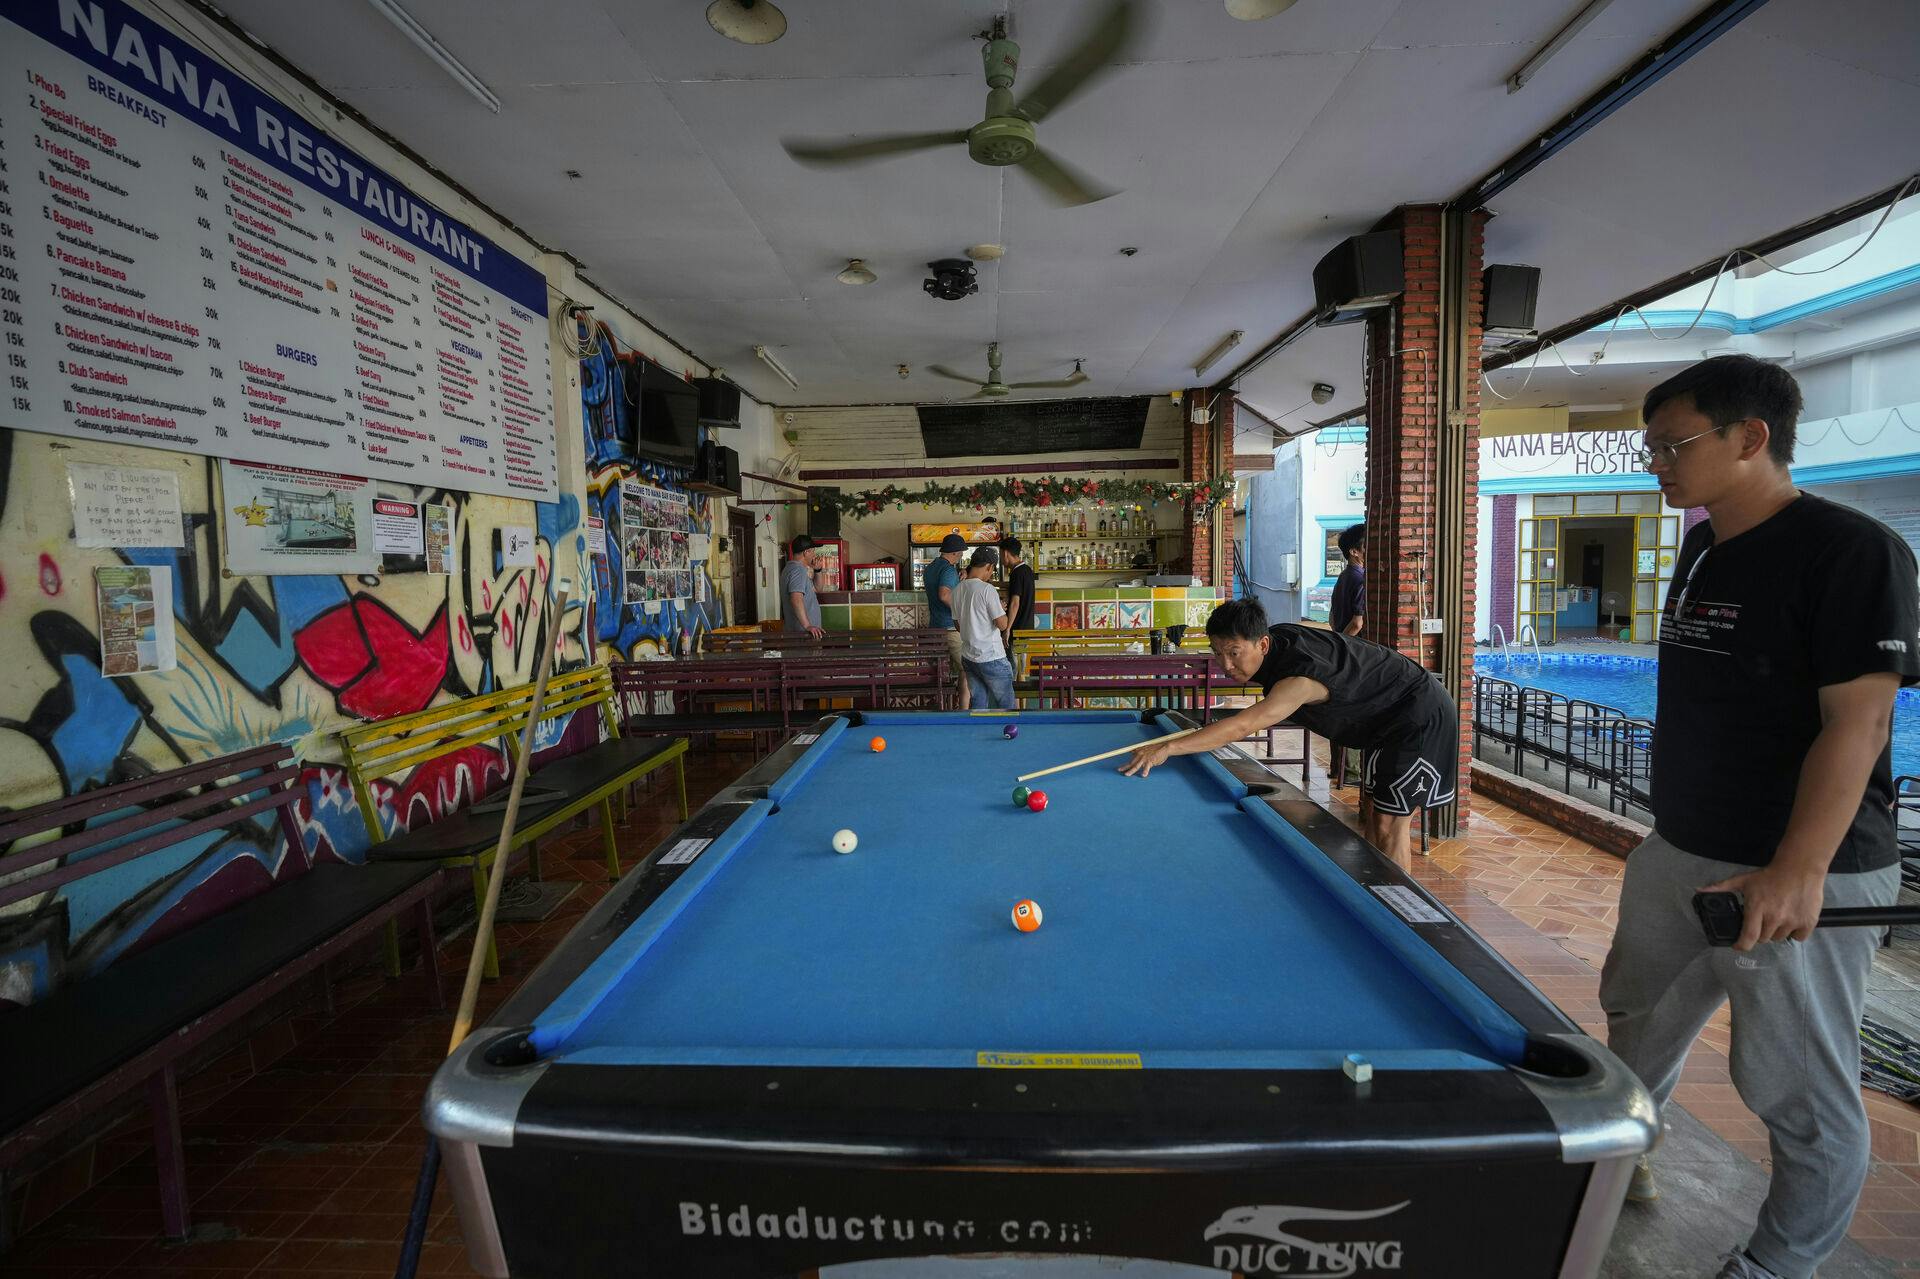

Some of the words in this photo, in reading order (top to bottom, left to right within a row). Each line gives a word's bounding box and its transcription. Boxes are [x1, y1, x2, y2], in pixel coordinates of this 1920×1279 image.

[34, 72, 53, 94] Pho
[54, 83, 66, 101] Bo
[87, 74, 167, 129] BREAKFAST
[28, 93, 39, 110] 2.
[40, 99, 74, 127] Special
[74, 116, 97, 138] Fried
[97, 127, 118, 148] Eggs
[57, 0, 241, 133] NANA
[256, 106, 484, 271] RESTAURANT
[34, 133, 44, 150] 3.
[44, 138, 69, 162] Fried
[69, 149, 91, 170] Eggs
[192, 155, 206, 171] 60k
[227, 153, 247, 172] Grilled
[247, 166, 267, 184] cheese
[268, 178, 294, 198] sandwich
[48, 174, 91, 202] Omelette
[195, 185, 208, 200] 50k
[231, 180, 245, 196] Ham
[245, 188, 267, 206] cheese
[267, 199, 293, 220] sandwich
[42, 205, 52, 221] 5.
[52, 209, 94, 235] Baguette
[233, 207, 249, 224] Tuna
[249, 215, 277, 237] Sandwich
[200, 245, 214, 261] 30k
[236, 237, 261, 256] Chicken
[261, 247, 288, 268] Sandwich
[361, 226, 384, 249] LUNCH
[392, 243, 416, 265] DINNER
[46, 243, 56, 259] 6.
[56, 247, 95, 271] Pancake
[95, 260, 127, 281] Banana
[326, 255, 337, 269] 70k
[202, 276, 216, 291] 25k
[239, 264, 258, 281] Baked
[258, 271, 280, 290] Mashed
[279, 280, 304, 299] Potatoes
[1, 286, 20, 304] 20k
[3, 308, 23, 326] 20k
[50, 282, 60, 298] 7.
[61, 286, 97, 308] Chicken
[97, 297, 136, 319] Sandwich
[136, 309, 146, 323] w/
[147, 313, 177, 330] cheese
[181, 323, 200, 338] chips
[205, 306, 219, 321] 30k
[330, 306, 341, 319] 70k
[510, 305, 534, 325] SPAGHETTI
[6, 331, 24, 347] 15k
[54, 321, 64, 337] 8.
[64, 324, 100, 345] Chicken
[100, 334, 139, 355] Sandwich
[140, 344, 149, 357] w/
[150, 346, 173, 363] bacon
[207, 336, 221, 351] 70k
[276, 343, 319, 368] BURGERS
[358, 341, 374, 356] Chicken
[450, 339, 483, 361] VEGETARIAN
[8, 353, 27, 369] 15k
[58, 360, 68, 374] 9.
[68, 362, 88, 378] Club
[88, 368, 128, 386] Sandwich
[210, 366, 224, 380] 70k
[243, 361, 268, 377] Chicken
[267, 368, 286, 382] Burger
[370, 370, 382, 383] Curry
[10, 375, 29, 390] 15k
[213, 395, 226, 409] 60k
[247, 385, 269, 400] Cheese
[269, 391, 287, 405] Burger
[344, 388, 354, 399] 70k
[373, 395, 389, 408] Chicken
[13, 397, 31, 412] 15k
[63, 400, 76, 413] 10.
[76, 401, 111, 419] Smoked
[111, 408, 141, 425] Salmon
[141, 414, 177, 430] Sandwich
[249, 413, 263, 425] Beef
[263, 416, 281, 430] Burger
[346, 411, 355, 422] 70k
[215, 425, 229, 438] 70k
[375, 420, 391, 433] Chicken
[347, 434, 357, 445] 70k
[459, 434, 488, 450] APPETIZERS
[1492, 433, 1546, 459] NANA
[381, 504, 411, 515] WARNING
[1707, 608, 1719, 617] on
[1720, 608, 1739, 619] Pink
[1019, 905, 1027, 915] 13
[1212, 1243, 1292, 1273] DUC
[1303, 1240, 1404, 1273] TUNG
